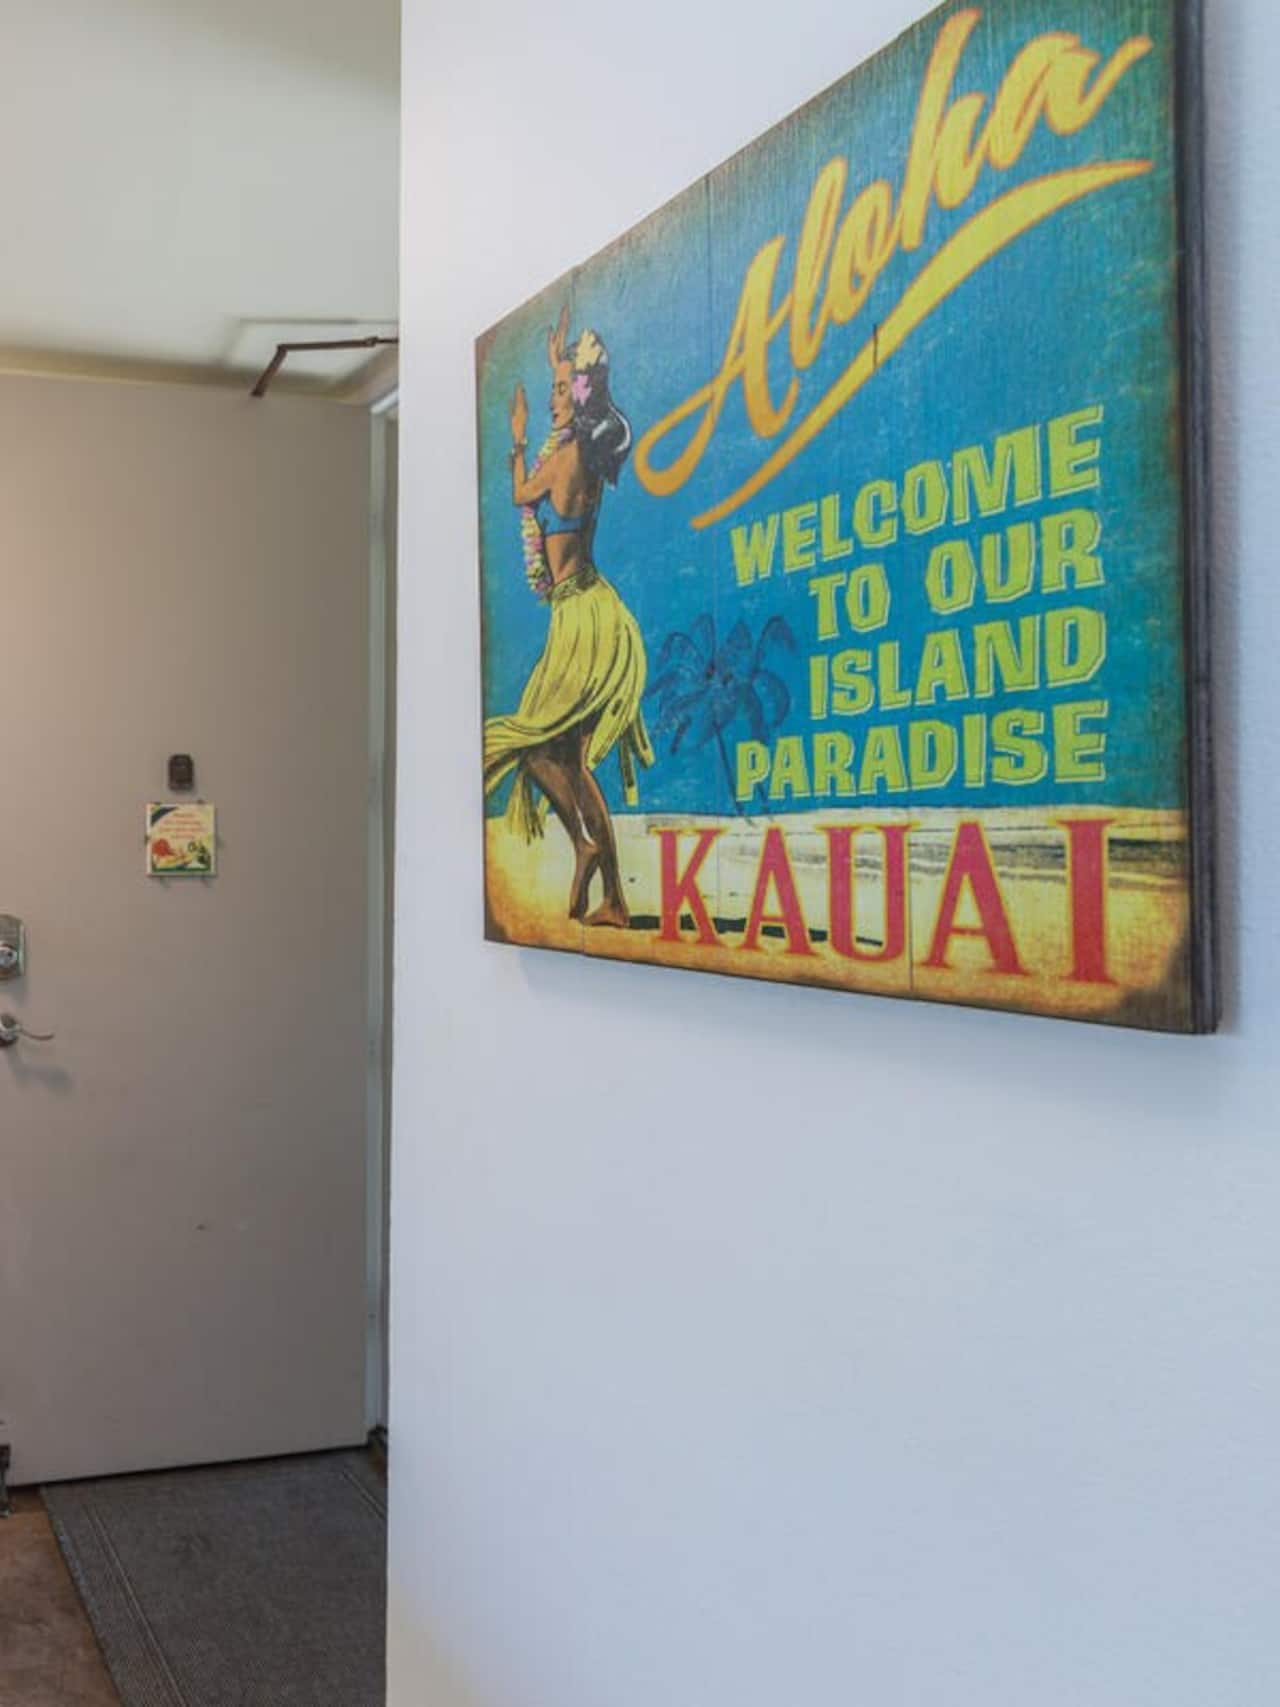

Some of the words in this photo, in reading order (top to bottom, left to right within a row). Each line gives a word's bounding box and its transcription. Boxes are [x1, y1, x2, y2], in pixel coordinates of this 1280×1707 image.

[634, 8, 1153, 497] Aloha
[729, 404, 1103, 588] WELCOME
[809, 563, 890, 641] TO
[925, 506, 1104, 615] OUR
[809, 606, 1107, 720] ISLAND
[735, 700, 1109, 801] PARADISE
[652, 816, 1120, 987] KAUAI
